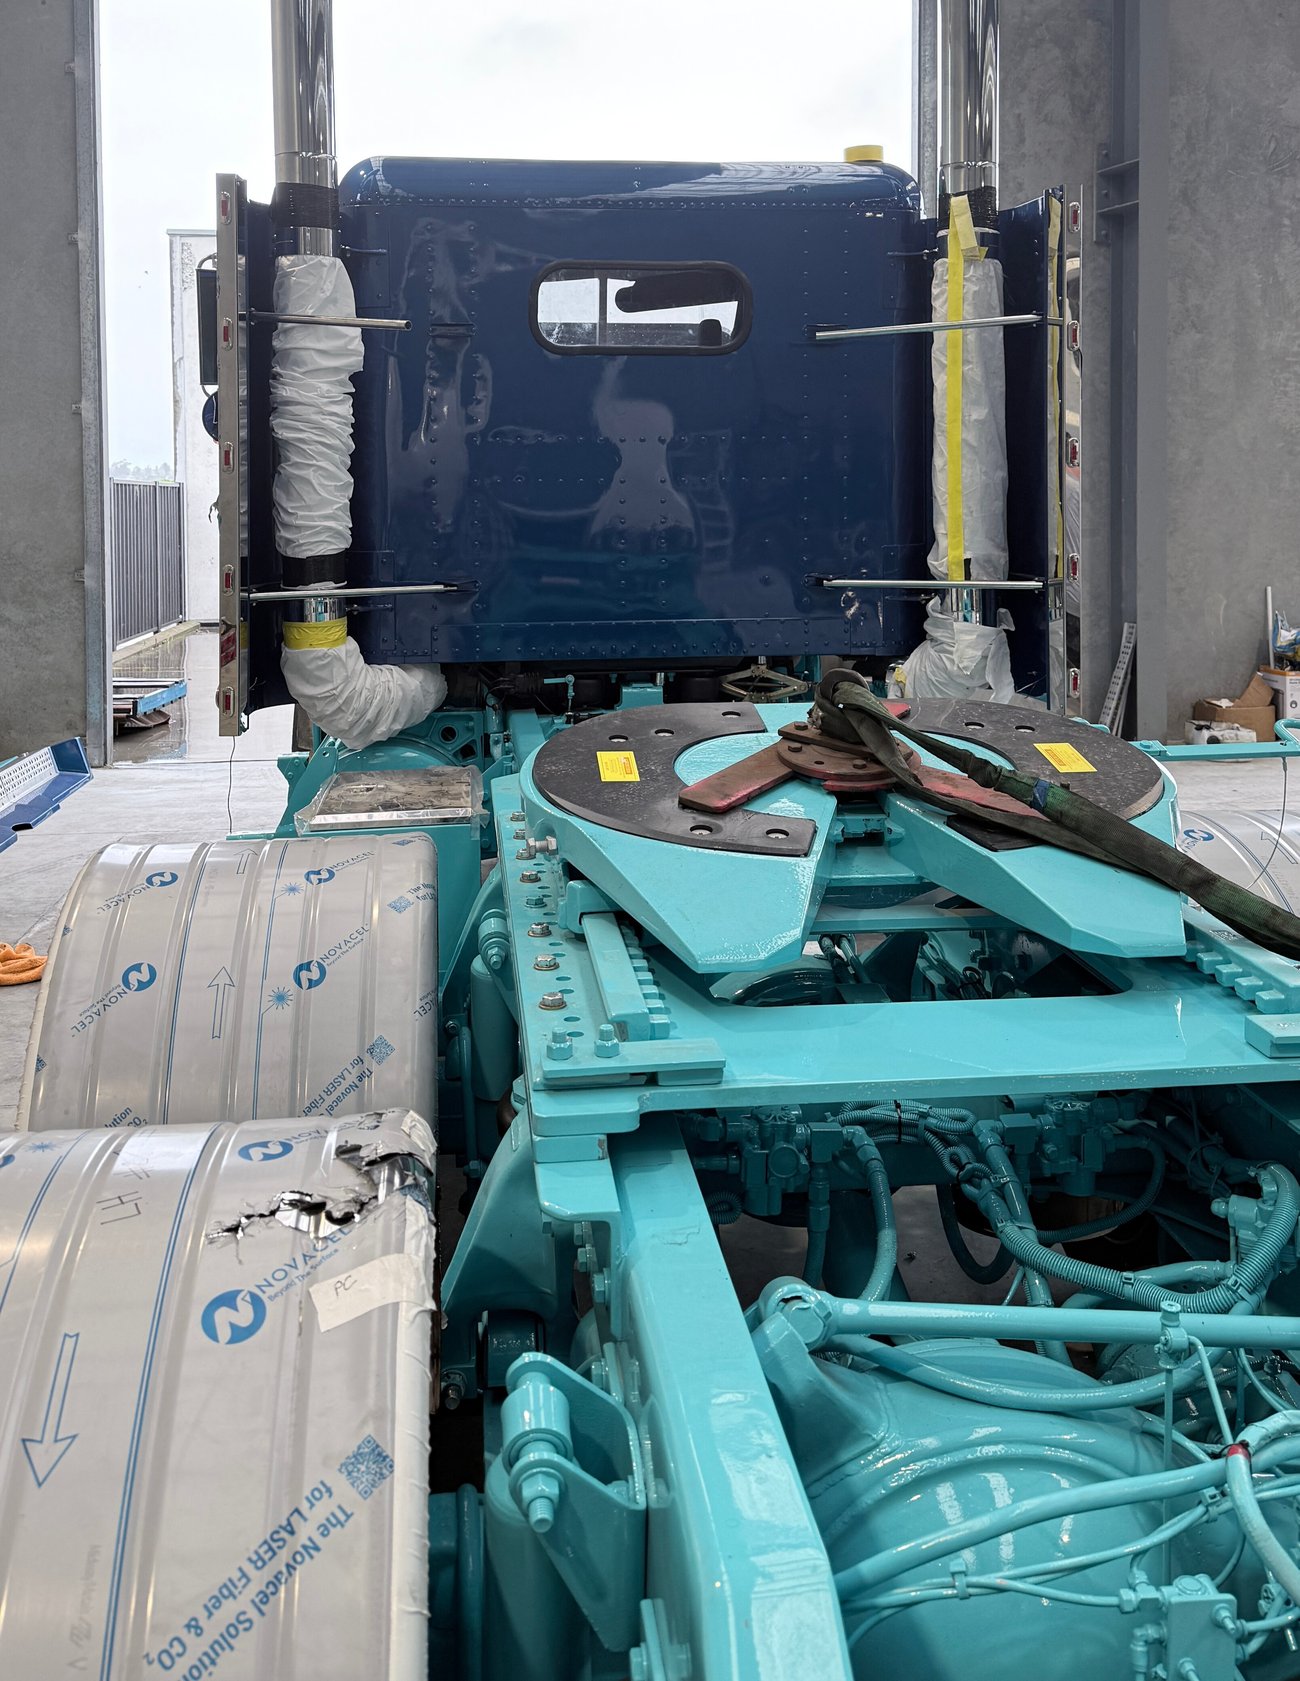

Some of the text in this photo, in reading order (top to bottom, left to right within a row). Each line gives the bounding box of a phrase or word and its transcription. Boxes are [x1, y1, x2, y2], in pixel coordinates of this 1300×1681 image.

[320, 926, 370, 963] NOVACEL
[71, 988, 128, 1033] NOVACEL
[302, 1055, 364, 1117] for LASER Fiber
[356, 1067, 373, 1083] The
[325, 1081, 359, 1117] Novacel
[304, 1480, 334, 1511] for
[246, 1507, 309, 1571] LASER
[316, 1504, 354, 1538] The
[202, 1566, 251, 1620] Fiber
[251, 1536, 322, 1617] Novacel
[183, 1617, 204, 1637] &
